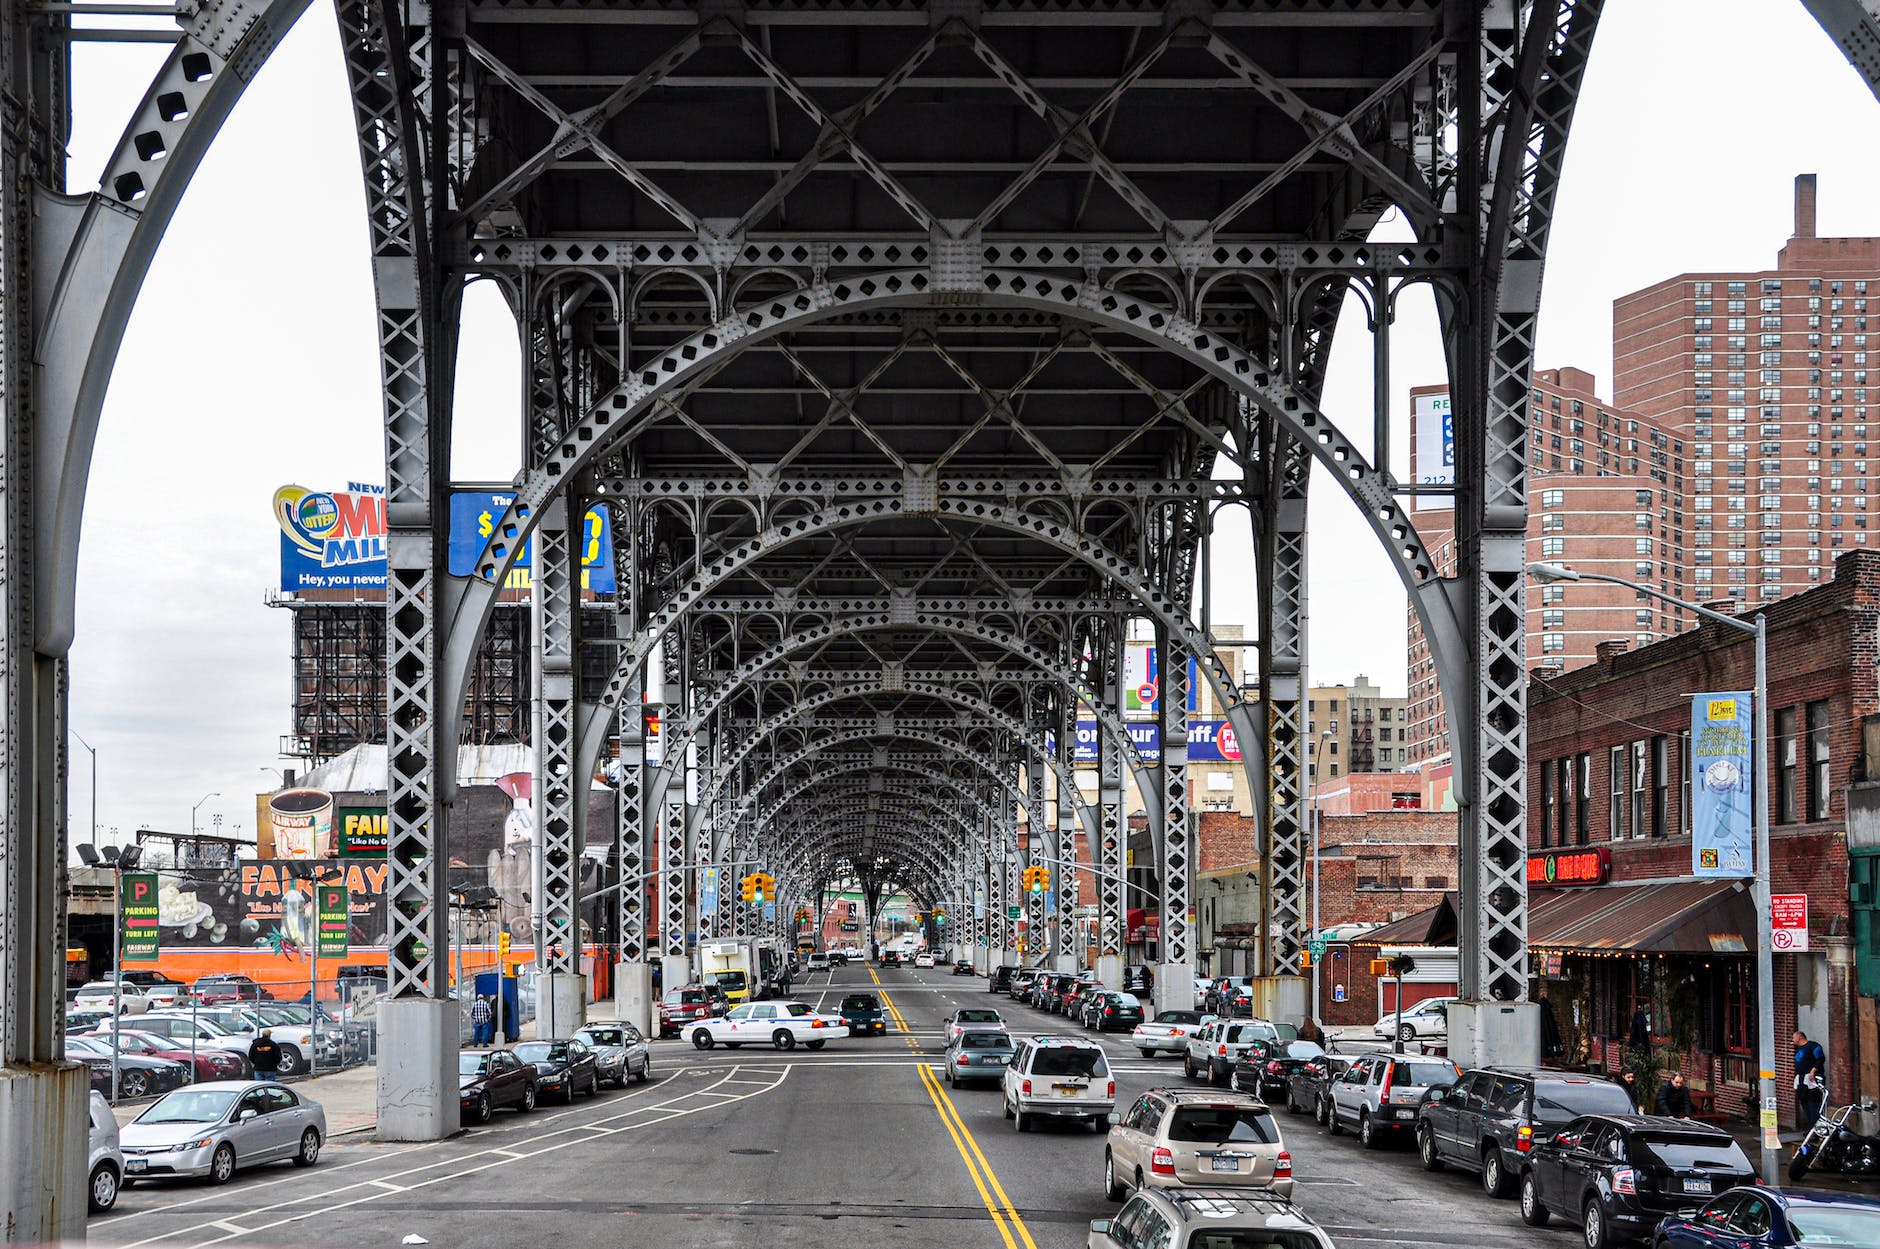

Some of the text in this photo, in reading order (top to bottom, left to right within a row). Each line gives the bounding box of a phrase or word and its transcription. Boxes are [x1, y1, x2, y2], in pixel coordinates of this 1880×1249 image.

[348, 481, 385, 494] NEW
[302, 513, 337, 529] LOTTERY
[299, 573, 387, 587] Hey, you never
[1697, 745, 1748, 757] HARLEM
[272, 814, 314, 828] FAIRWAY
[368, 838, 380, 846] No
[135, 882, 148, 900] P
[328, 893, 339, 908] P
[125, 907, 158, 916] PARKING
[320, 913, 347, 921] PARKING
[125, 930, 158, 938] TURN LEFT
[126, 944, 156, 952] FAIRWAY
[321, 944, 346, 952] FAIRWAY
